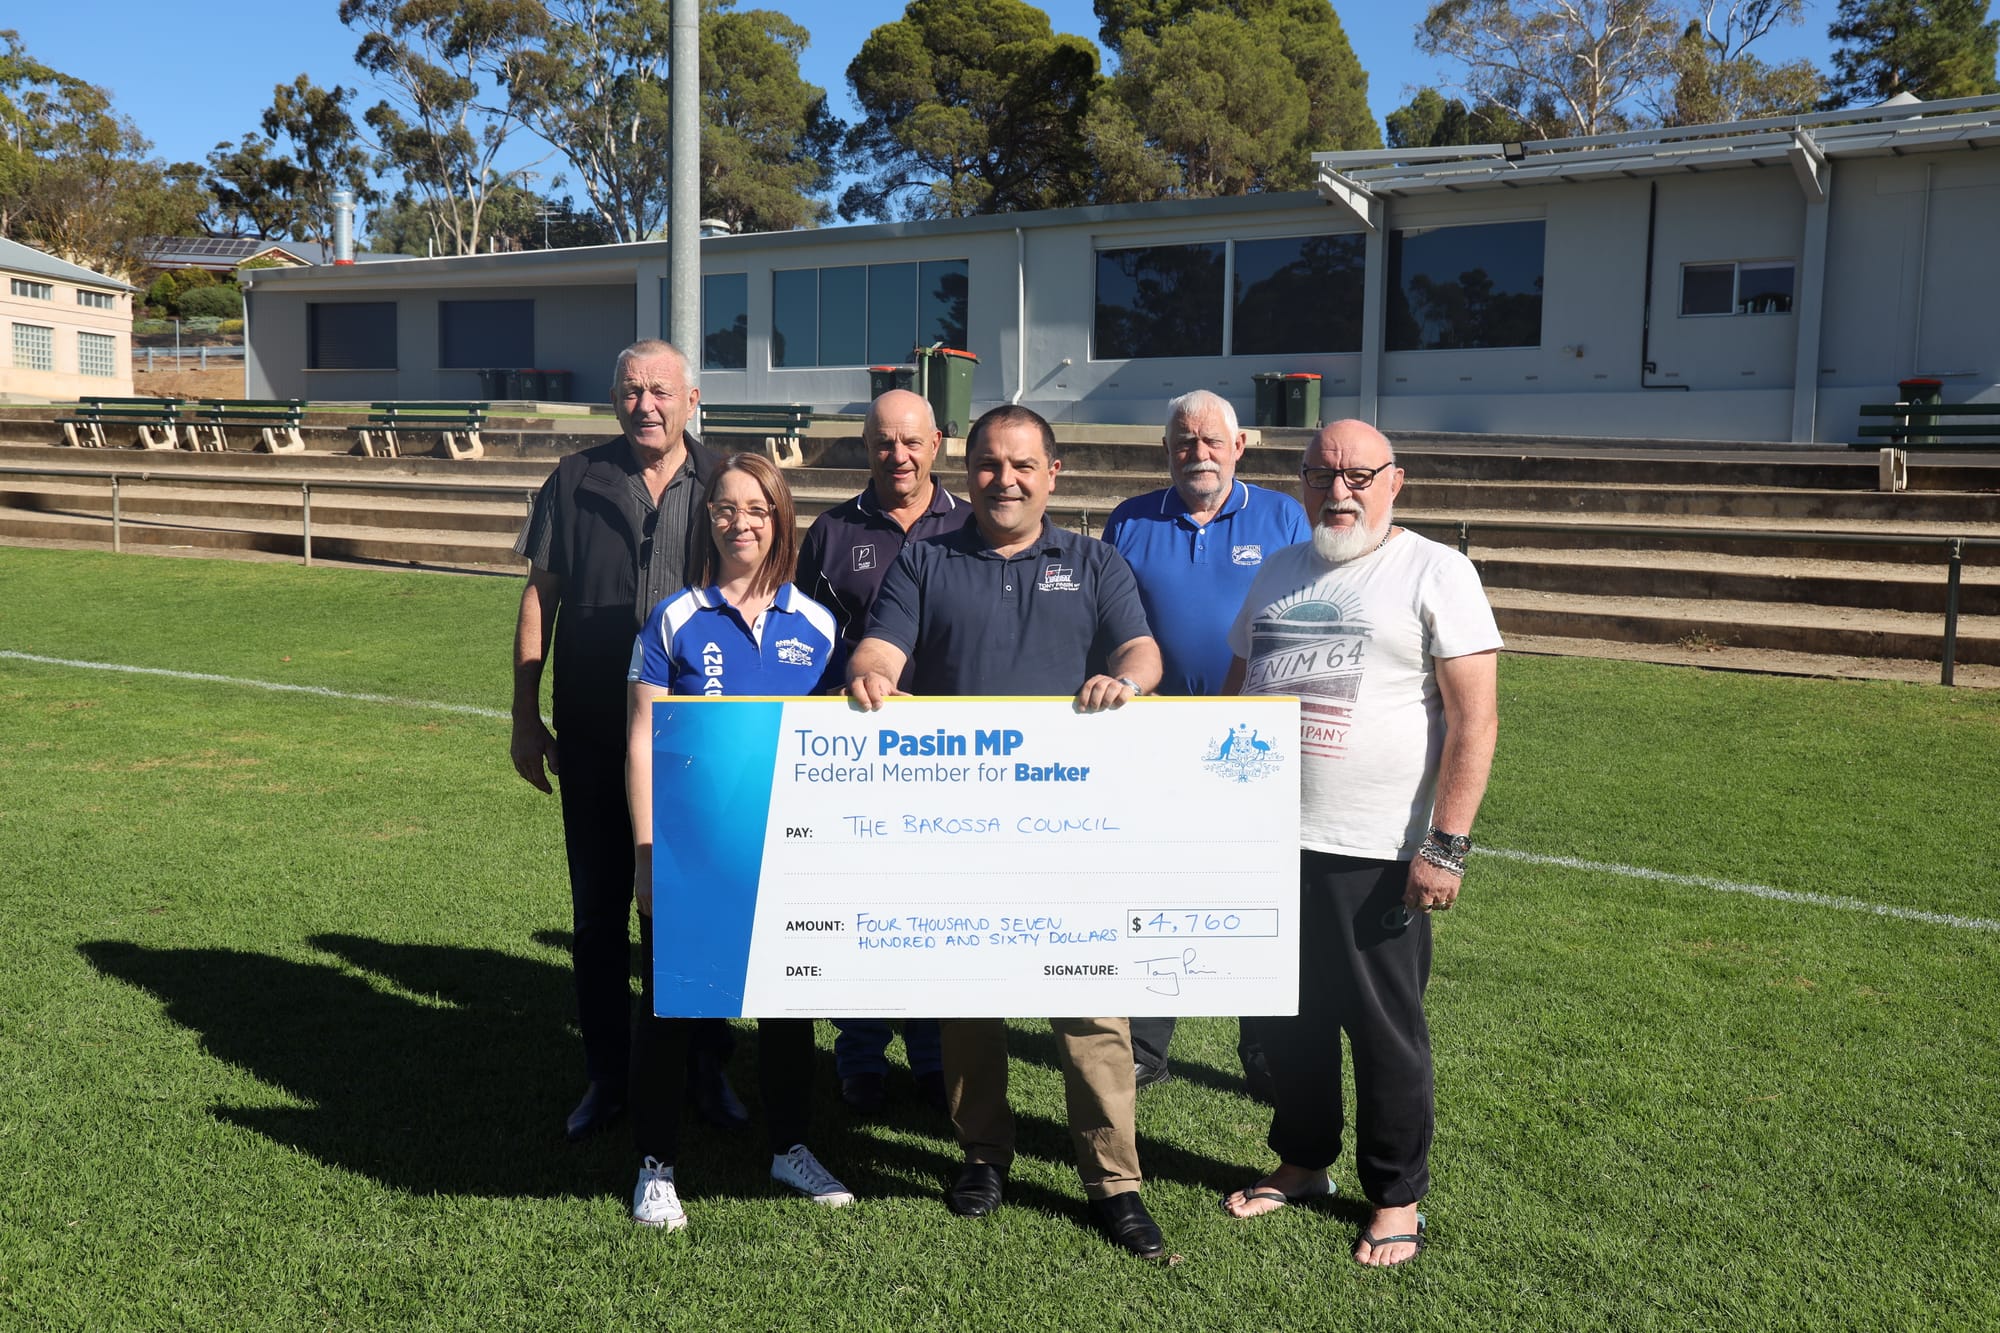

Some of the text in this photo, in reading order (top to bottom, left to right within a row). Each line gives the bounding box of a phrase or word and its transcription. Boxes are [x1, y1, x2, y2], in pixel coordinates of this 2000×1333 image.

[1326, 640, 1364, 668] 64
[794, 728, 1024, 762] Tony Pasin MP
[795, 762, 1090, 783] Federal Member for Barker
[786, 827, 813, 839] PAY:
[843, 814, 1120, 839] THE BAROSSA COUNCIL
[786, 920, 845, 932] AMOUNT:
[856, 912, 1062, 932] FOUR THOUSAND SEVEN
[1132, 917, 1142, 932] $
[1148, 912, 1241, 934] 4,760
[858, 928, 1118, 950] HUNDRED AND SIXTY DOLLARS
[786, 965, 822, 977] DATE:
[1043, 964, 1118, 976] SIGNATURE:
